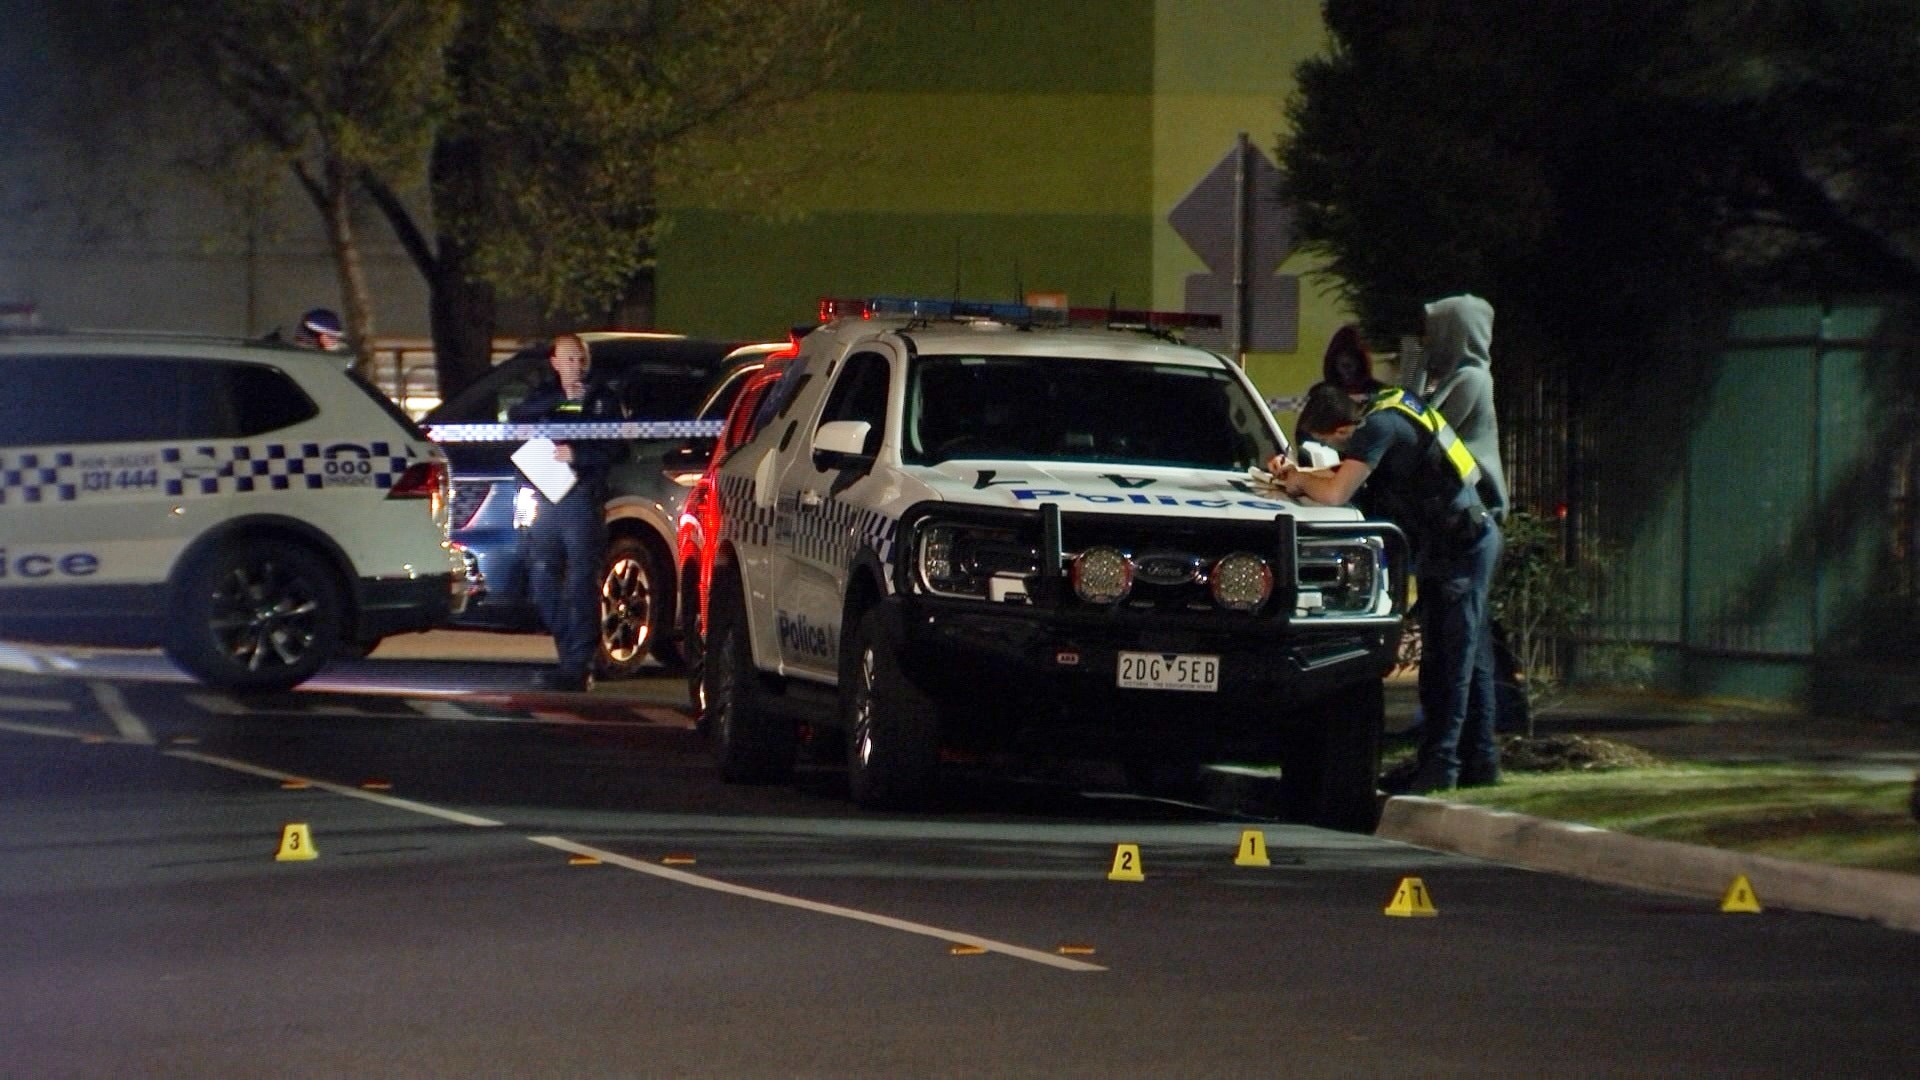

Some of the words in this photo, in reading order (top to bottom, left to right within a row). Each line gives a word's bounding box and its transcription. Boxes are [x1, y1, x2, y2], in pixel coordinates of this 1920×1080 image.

[82, 471, 111, 489] 131
[113, 469, 158, 488] 444
[1011, 489, 1286, 511] Police
[779, 613, 827, 656] Police
[1122, 658, 1160, 681] 2DG
[1177, 660, 1215, 683] 5EB
[289, 832, 300, 850] 3
[1249, 837, 1256, 855] 1
[1122, 851, 1132, 870] 2
